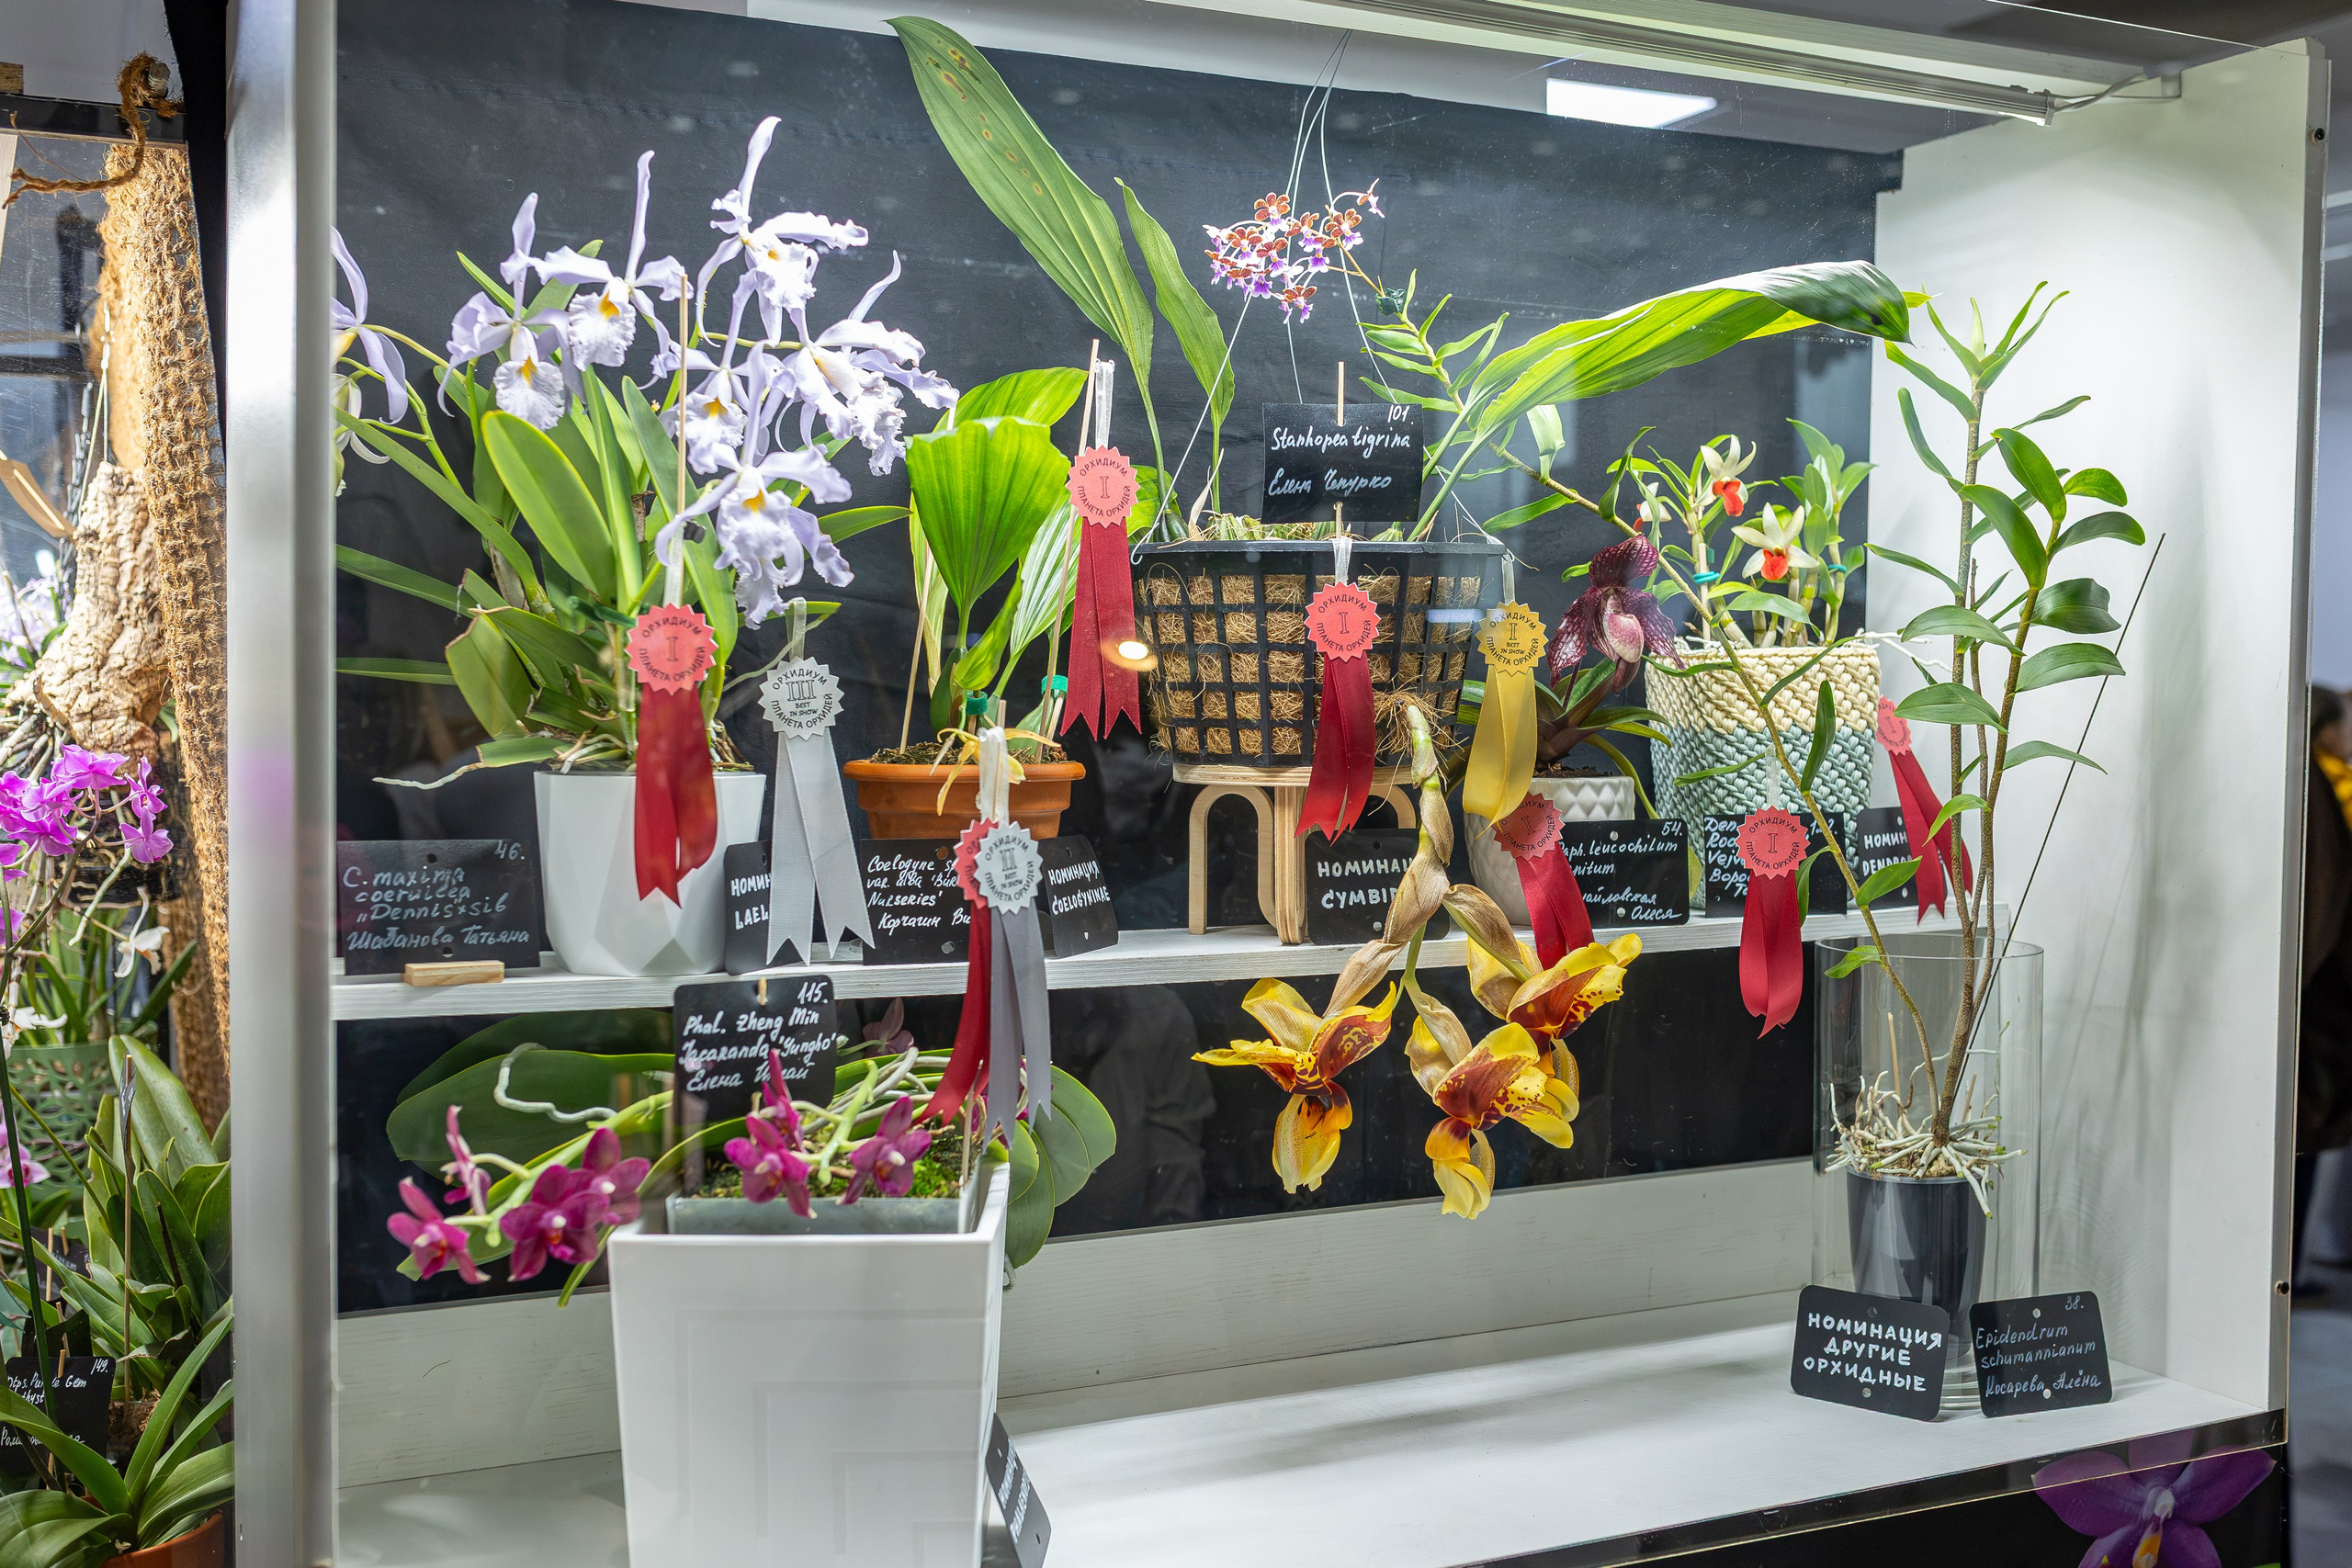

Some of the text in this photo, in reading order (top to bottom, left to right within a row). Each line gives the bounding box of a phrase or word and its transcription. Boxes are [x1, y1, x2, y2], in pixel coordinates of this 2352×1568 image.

[1271, 425, 1410, 458] Stanhopea tigrina
[1080, 458, 1127, 476] ОРХИДИУМ
[1268, 468, 1312, 496] Елена
[1078, 486, 1131, 516] ПЛАНЕТА ОРХИДЕЙ
[1317, 594, 1367, 614] ОРХИДИУМ
[1489, 613, 1537, 630] ОРХИДИУМ
[1317, 620, 1371, 651] ПЛАНЕТА ОРХИДЕЙ
[1487, 637, 1539, 666] ПЛАНЕТА ОРХИДЕЙ
[773, 669, 828, 690] ОРХИДИУМ
[786, 680, 817, 702] III
[771, 693, 833, 729] ПЛАНЕТА ОРХИДЕЙ
[1504, 815, 1555, 851] ПЛАНЕТА ОРХИДЕЙ
[1749, 818, 1797, 833] ОРХИДИУМ
[1864, 831, 1908, 850] НОМИН
[867, 853, 935, 879] Coelogyne
[1746, 841, 1800, 869] ПЛАНЕТА ОРХИДЕЙ
[372, 865, 465, 886] maxima
[730, 873, 771, 897] НОМИН
[1047, 860, 1100, 886] НОМИНАЦИЯ
[1052, 886, 1111, 916] COELOGYNINAE
[1582, 886, 1657, 905] айловская
[735, 904, 770, 931] LAEL
[460, 924, 530, 945] Татьяна
[683, 1007, 820, 1042] Phal. Zheng Min
[686, 1068, 744, 1092] Елена
[1807, 1312, 1942, 1351] НОМИНАЦИЯ
[1975, 1323, 2068, 1349] Epidendrum
[1824, 1337, 1911, 1366] ДРУГИЕ
[1981, 1340, 2096, 1369] schumannianum
[65, 1375, 86, 1388] Gem
[1804, 1357, 1927, 1392] ОРХИДНЫЕ
[1985, 1370, 2102, 1398] Косарева Алёна
